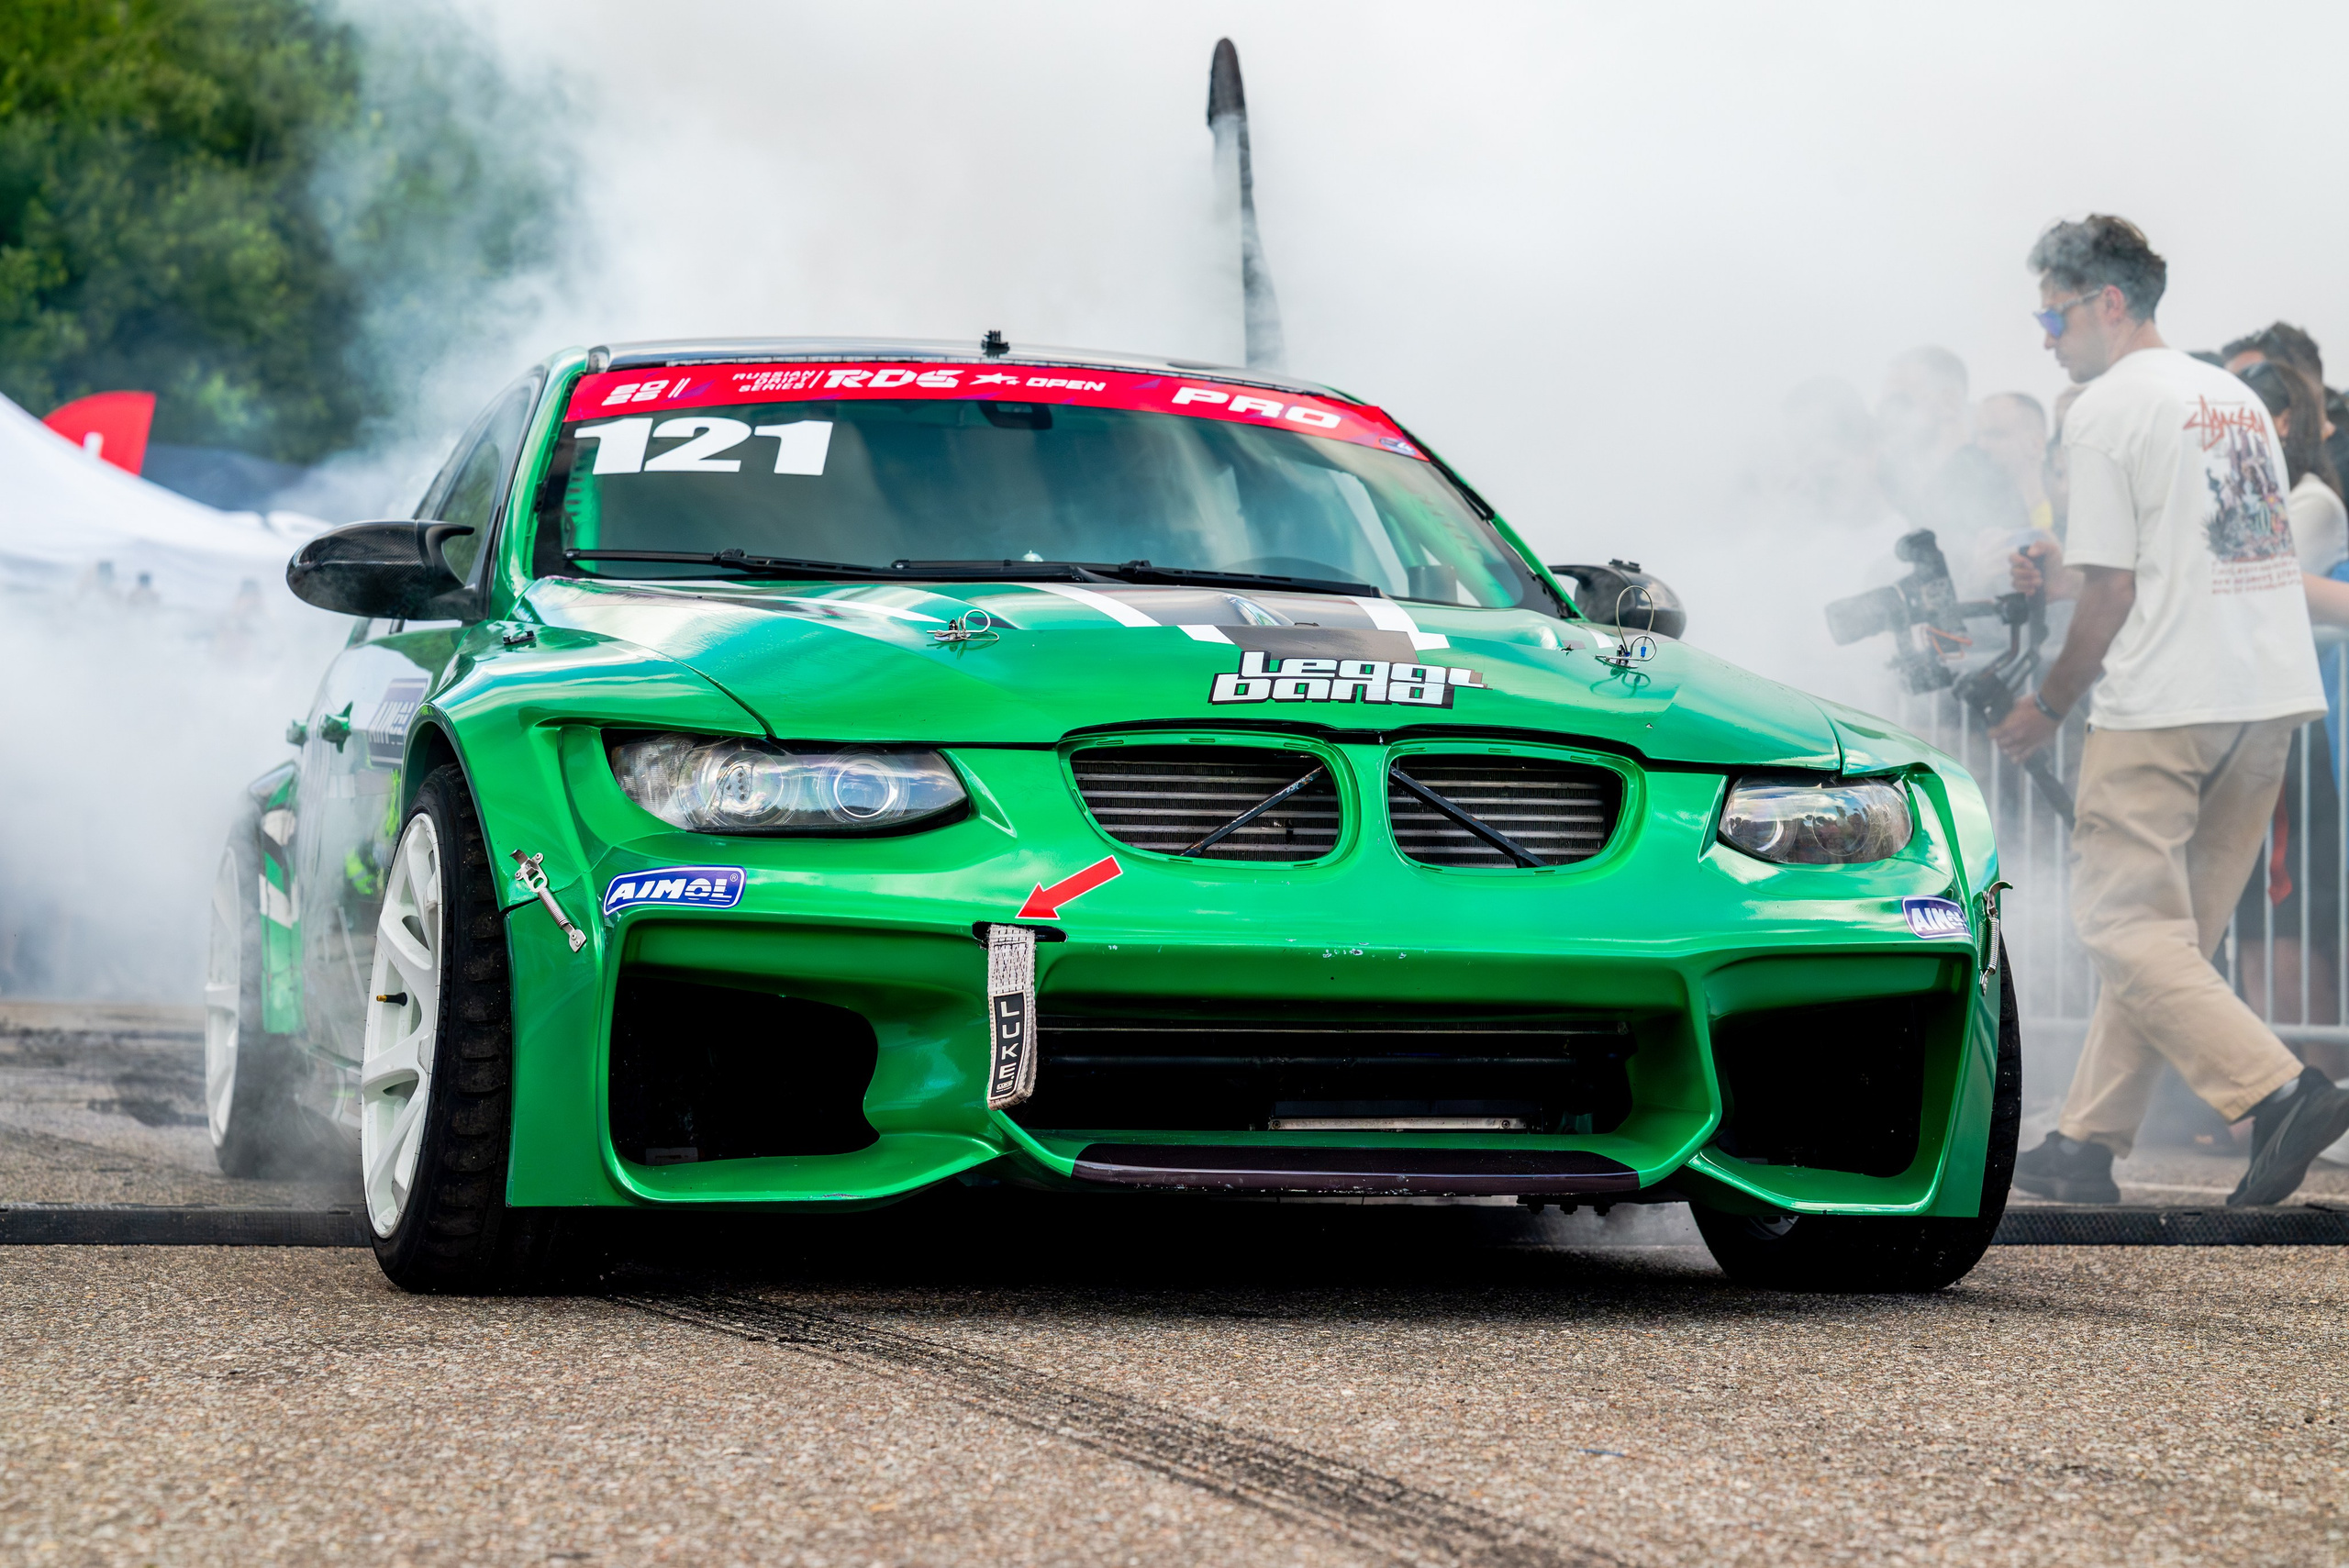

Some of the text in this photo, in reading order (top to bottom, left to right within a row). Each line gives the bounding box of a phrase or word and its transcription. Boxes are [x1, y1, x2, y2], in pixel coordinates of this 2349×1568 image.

[732, 370, 816, 381] RUSSIAN
[1026, 377, 1107, 391] OPEN
[1172, 386, 1341, 428] PRO
[573, 417, 833, 476] 121
[607, 878, 732, 906] AIMOL
[999, 1001, 1020, 1080] LUKE
